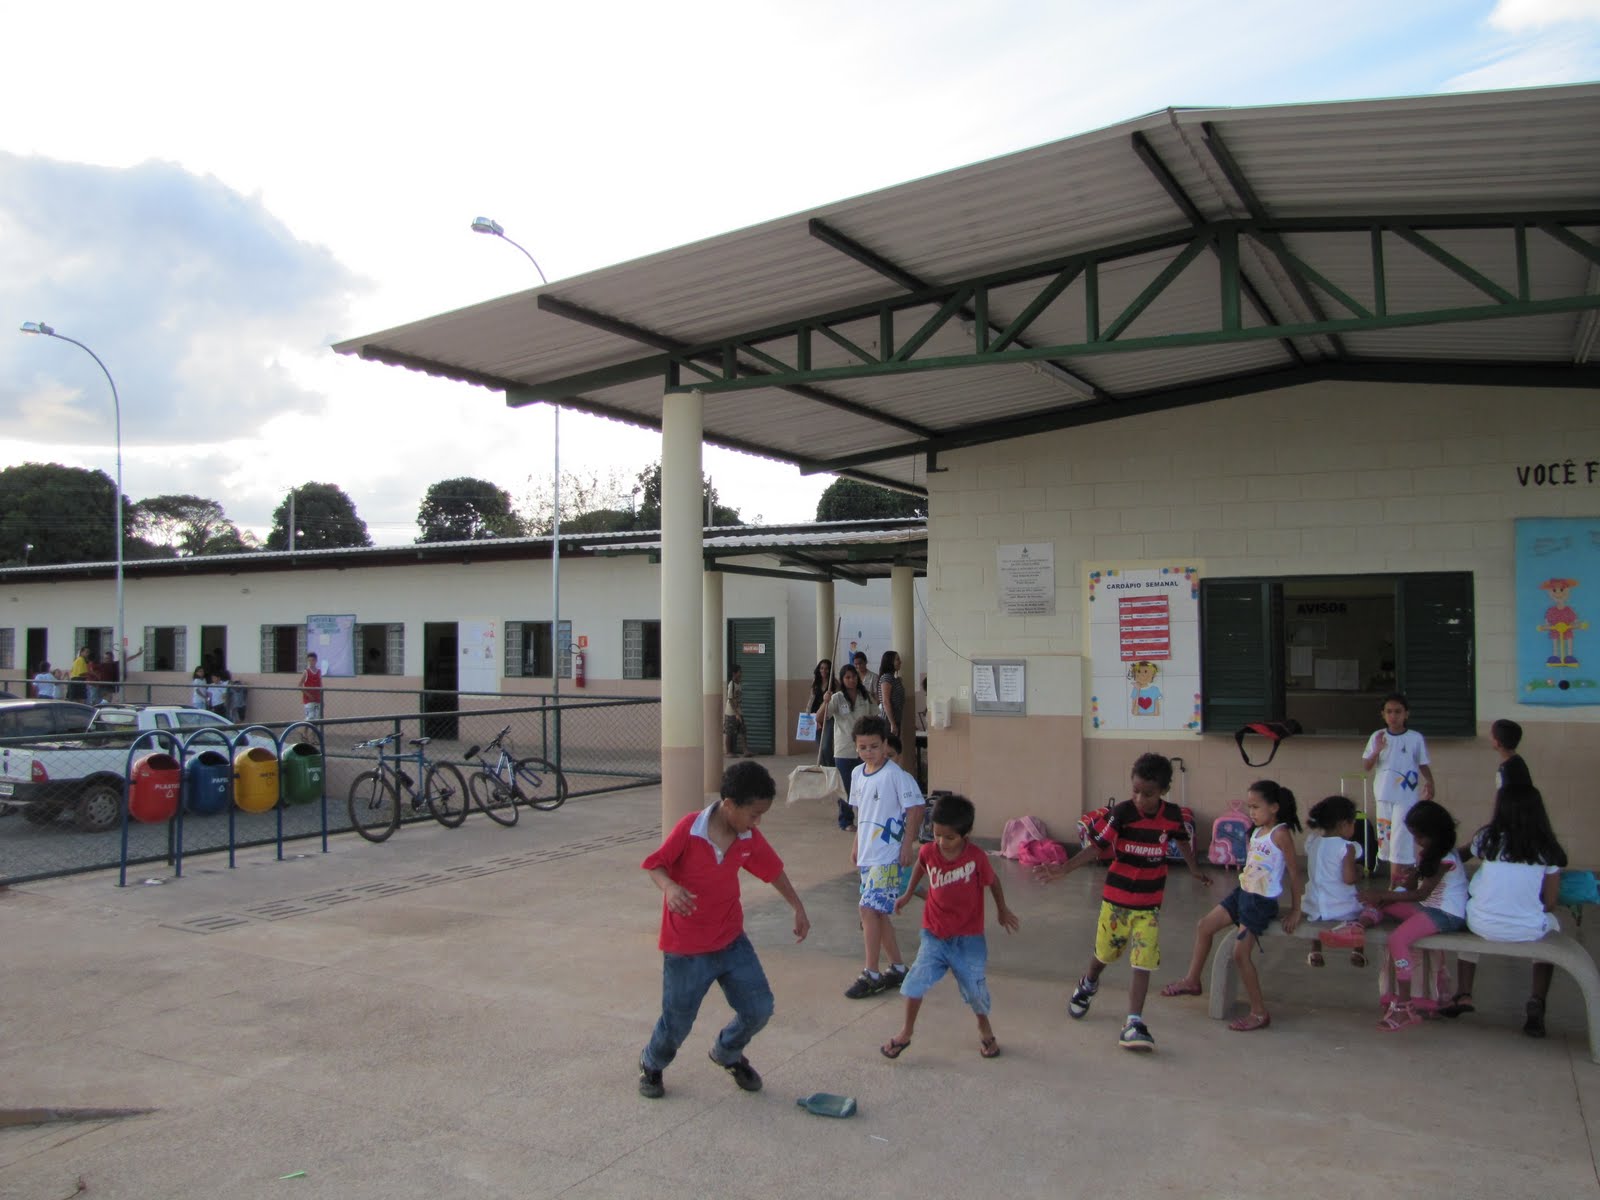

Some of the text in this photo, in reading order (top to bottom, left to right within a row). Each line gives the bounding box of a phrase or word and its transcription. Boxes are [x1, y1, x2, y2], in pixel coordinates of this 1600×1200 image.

[1516, 459, 1577, 487] VOCÊ
[1106, 582, 1142, 590] CARDÁPIO
[1297, 603, 1347, 616] AVISOS
[926, 860, 976, 890] Champ
